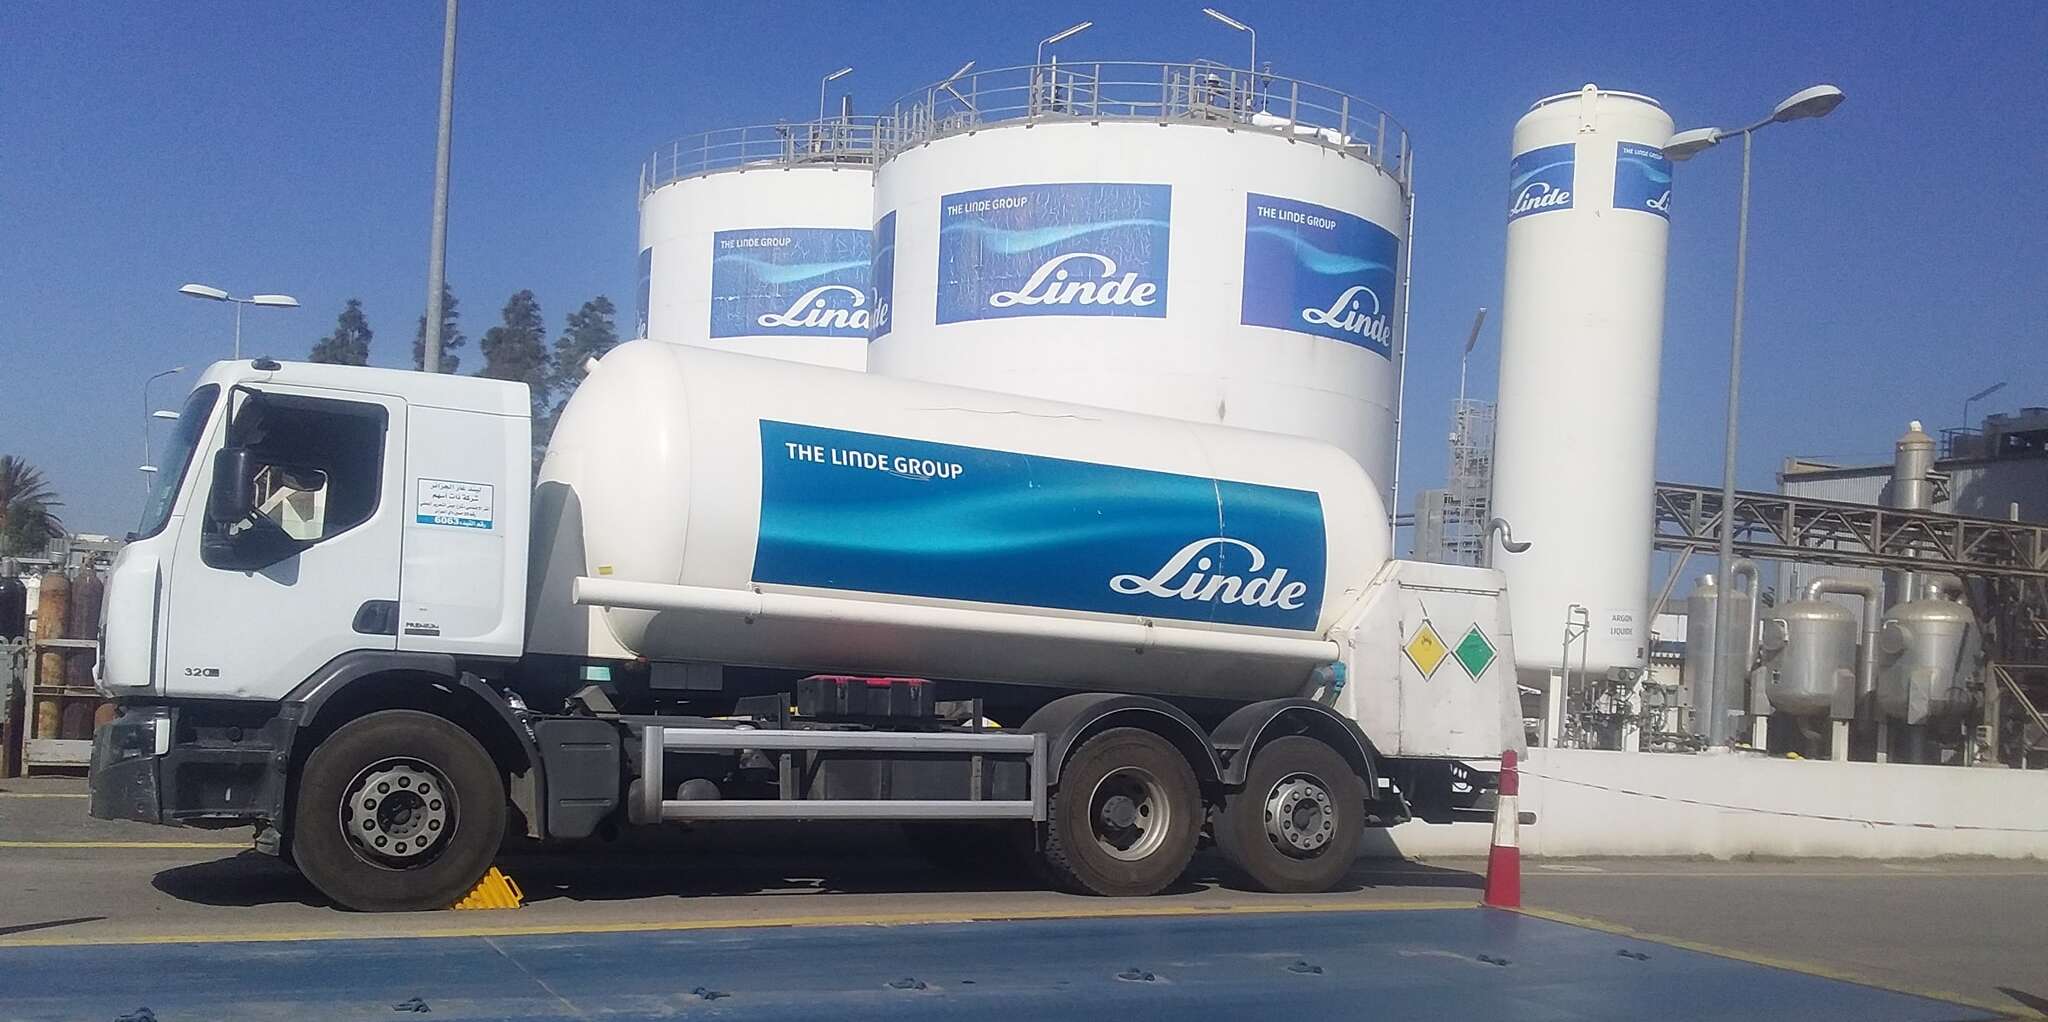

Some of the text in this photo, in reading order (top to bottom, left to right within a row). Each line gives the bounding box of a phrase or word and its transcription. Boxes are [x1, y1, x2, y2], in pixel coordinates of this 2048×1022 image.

[947, 196, 1028, 216] THE LINDE GROUP
[1509, 182, 1570, 217] Linde
[1257, 206, 1337, 230] THE LINDE GROUP
[720, 237, 792, 249] THE LINDE GROUP
[989, 252, 1157, 307] Linde
[1302, 285, 1392, 346] Linde
[785, 442, 963, 480] THE LINDE GROUP
[1109, 536, 1307, 610] Linde
